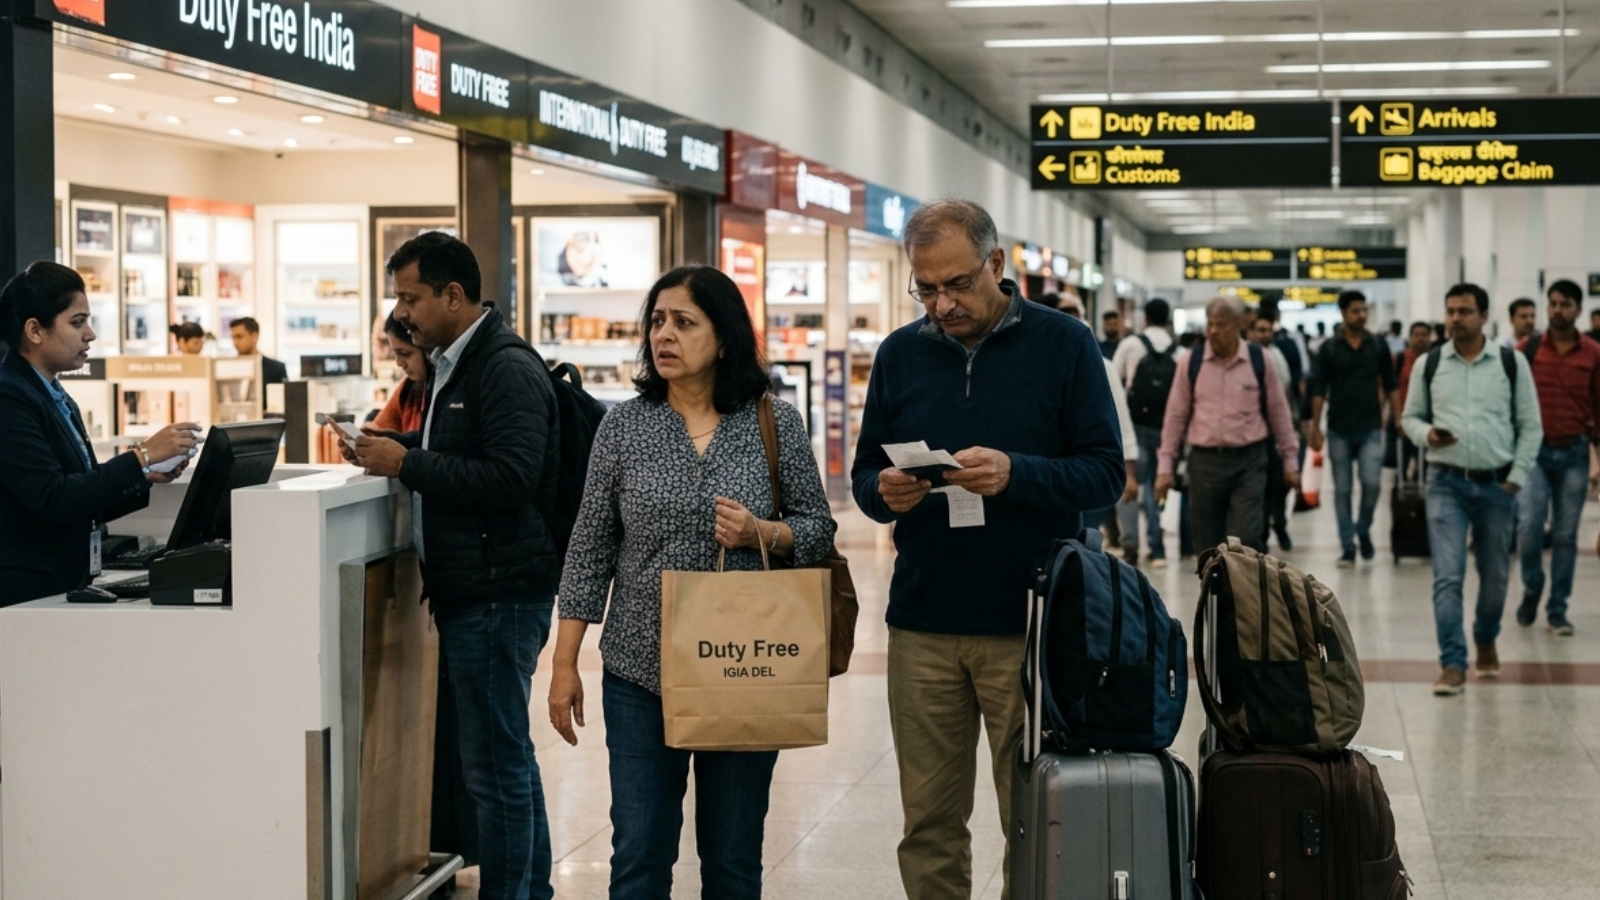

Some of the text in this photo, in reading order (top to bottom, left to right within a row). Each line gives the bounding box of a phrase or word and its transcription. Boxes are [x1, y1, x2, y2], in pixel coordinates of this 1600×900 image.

[247, 0, 297, 53] Free
[304, 2, 355, 71] India
[450, 62, 510, 109] DUTY FREE
[1105, 110, 1255, 136] Duty Free India
[1418, 106, 1497, 128] Arrivals
[1105, 165, 1180, 183] Customs
[1418, 160, 1554, 184] Baggage Claim
[699, 639, 799, 662] Duty Free
[723, 666, 776, 677] IGIA DEL
